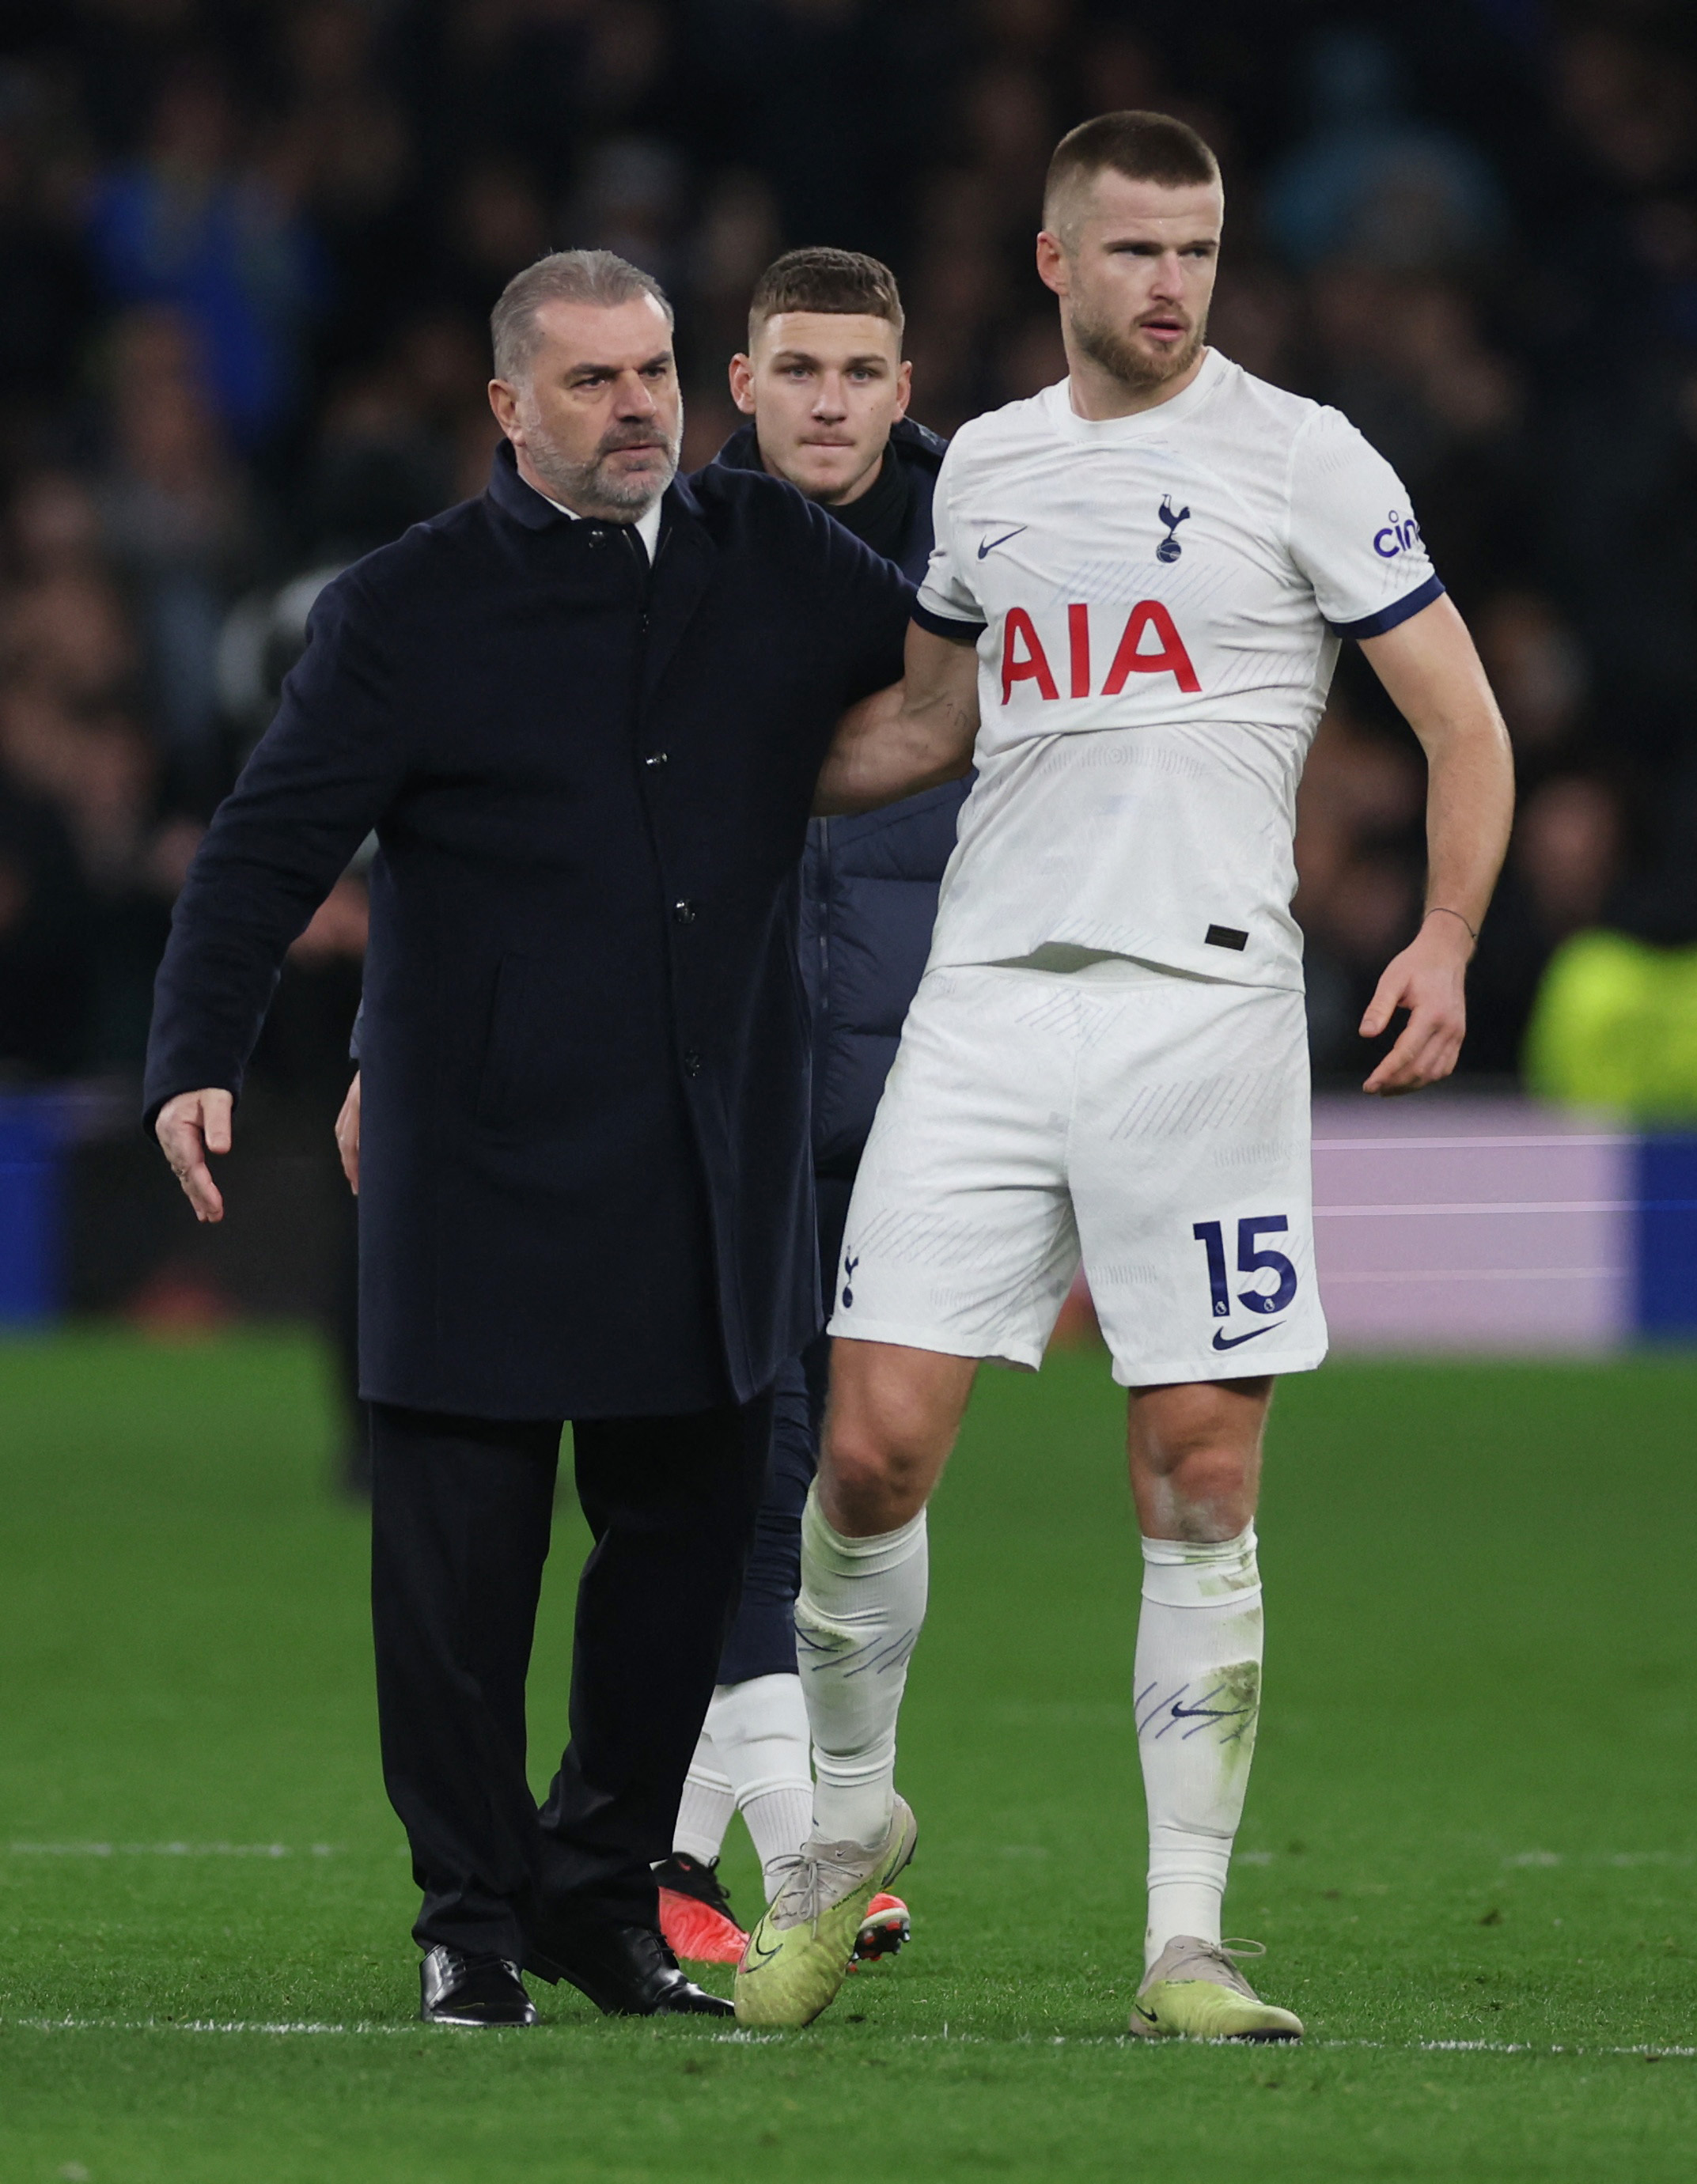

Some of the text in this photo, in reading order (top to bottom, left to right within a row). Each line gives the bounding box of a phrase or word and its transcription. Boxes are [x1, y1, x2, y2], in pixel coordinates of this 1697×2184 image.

[1373, 510, 1421, 558] cin
[1001, 600, 1203, 706] AIA
[1193, 1214, 1297, 1317] 15
